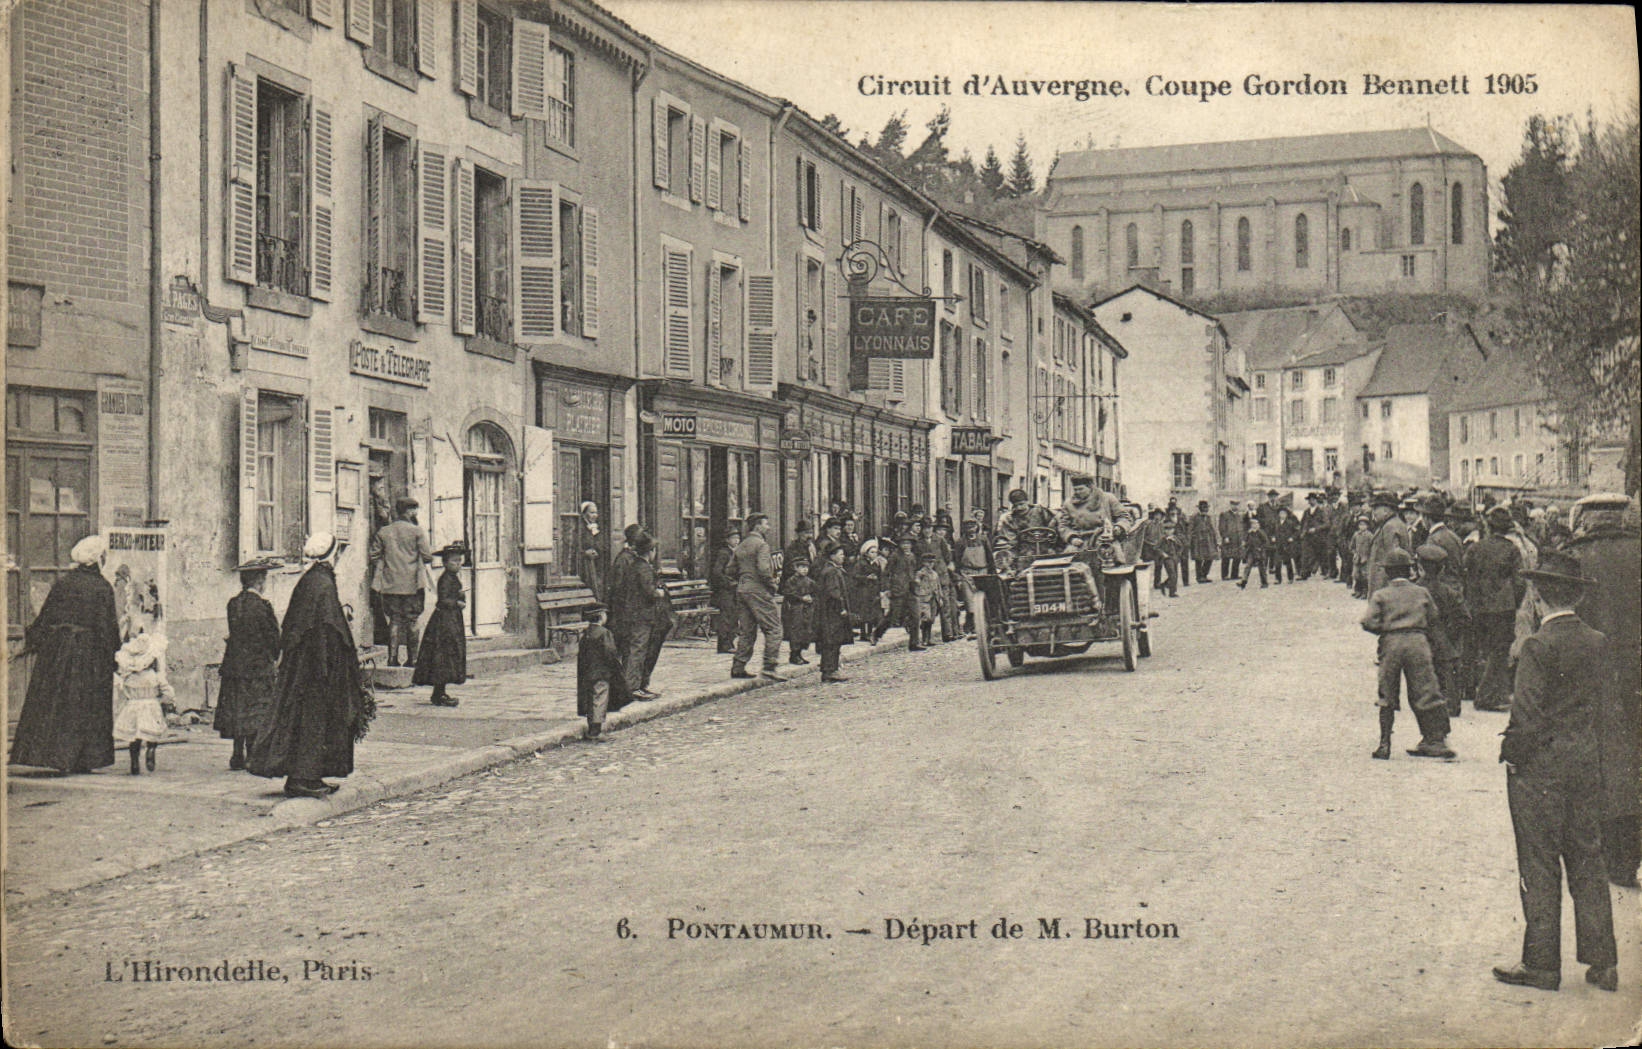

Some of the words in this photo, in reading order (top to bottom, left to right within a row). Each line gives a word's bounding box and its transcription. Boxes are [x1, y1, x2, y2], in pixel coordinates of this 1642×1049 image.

[854, 335, 930, 351] LYONNAIS
[353, 341, 379, 371] POSTE
[664, 417, 695, 433] MOTO
[952, 431, 991, 451] TABAC
